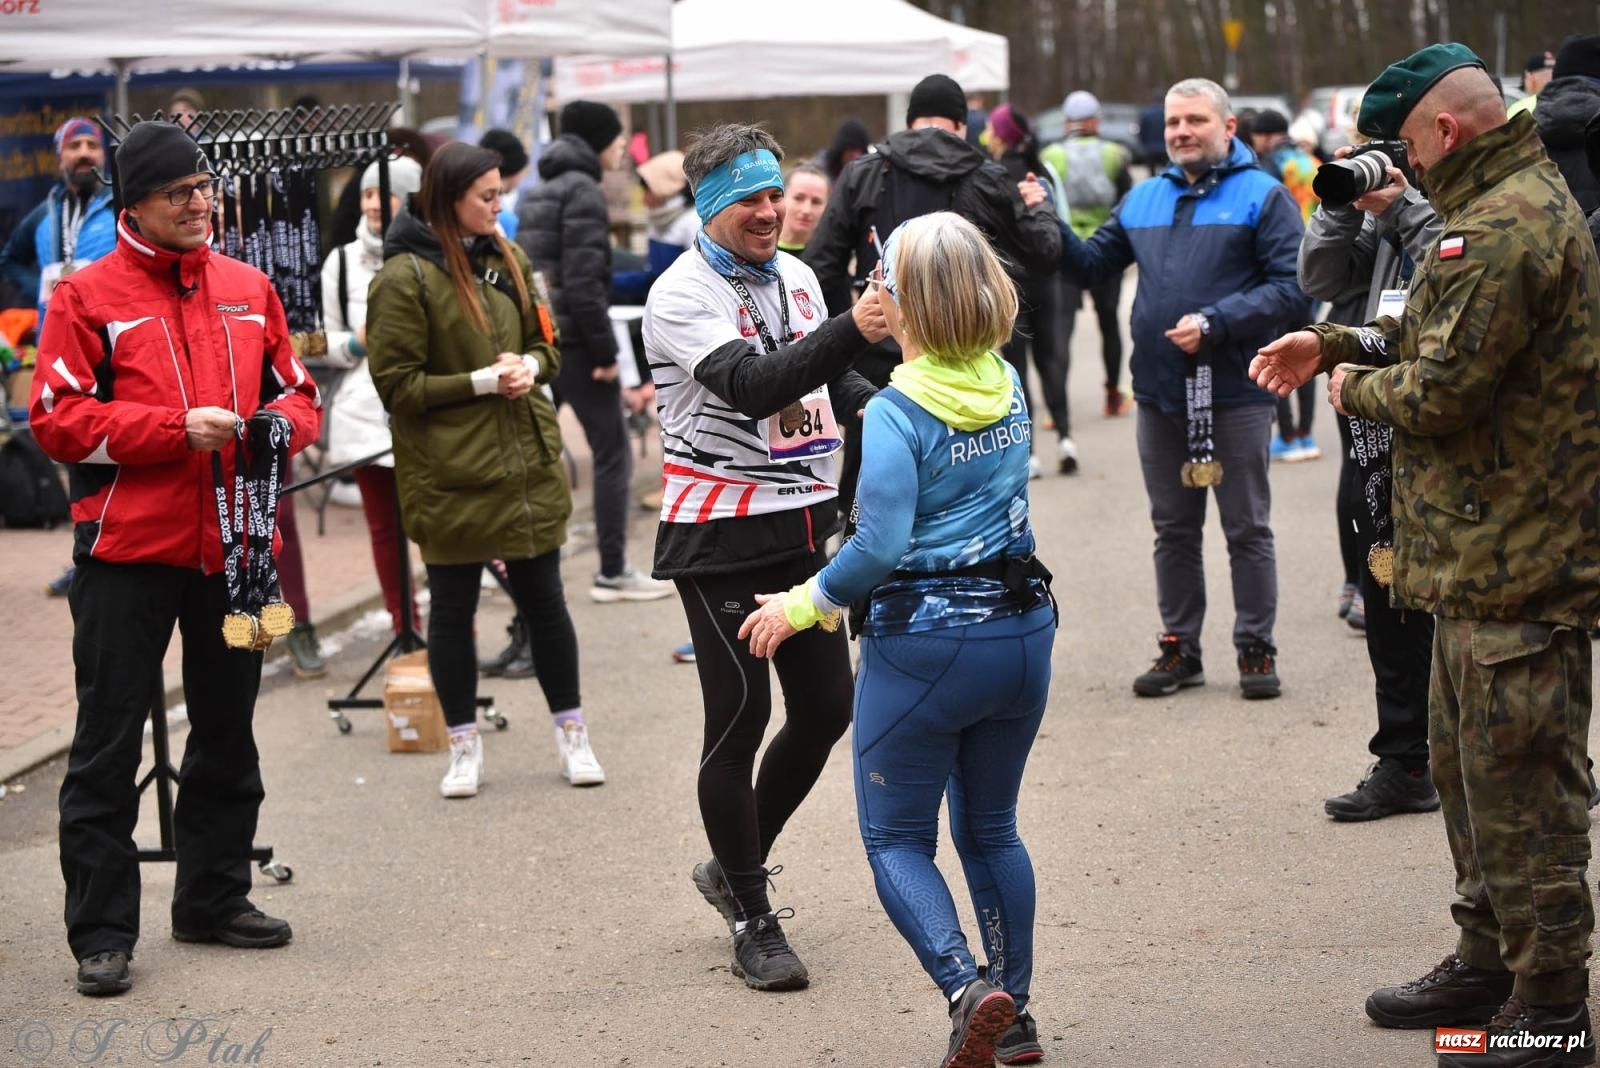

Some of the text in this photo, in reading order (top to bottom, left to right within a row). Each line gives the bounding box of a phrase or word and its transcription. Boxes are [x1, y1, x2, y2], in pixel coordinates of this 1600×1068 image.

[728, 278, 762, 324] 3.02.2025
[950, 417, 1032, 466] RACIBÓR
[216, 487, 233, 544] 23.02.2025
[234, 475, 244, 533] 23.02.2025
[245, 481, 268, 537] 23.02.2025
